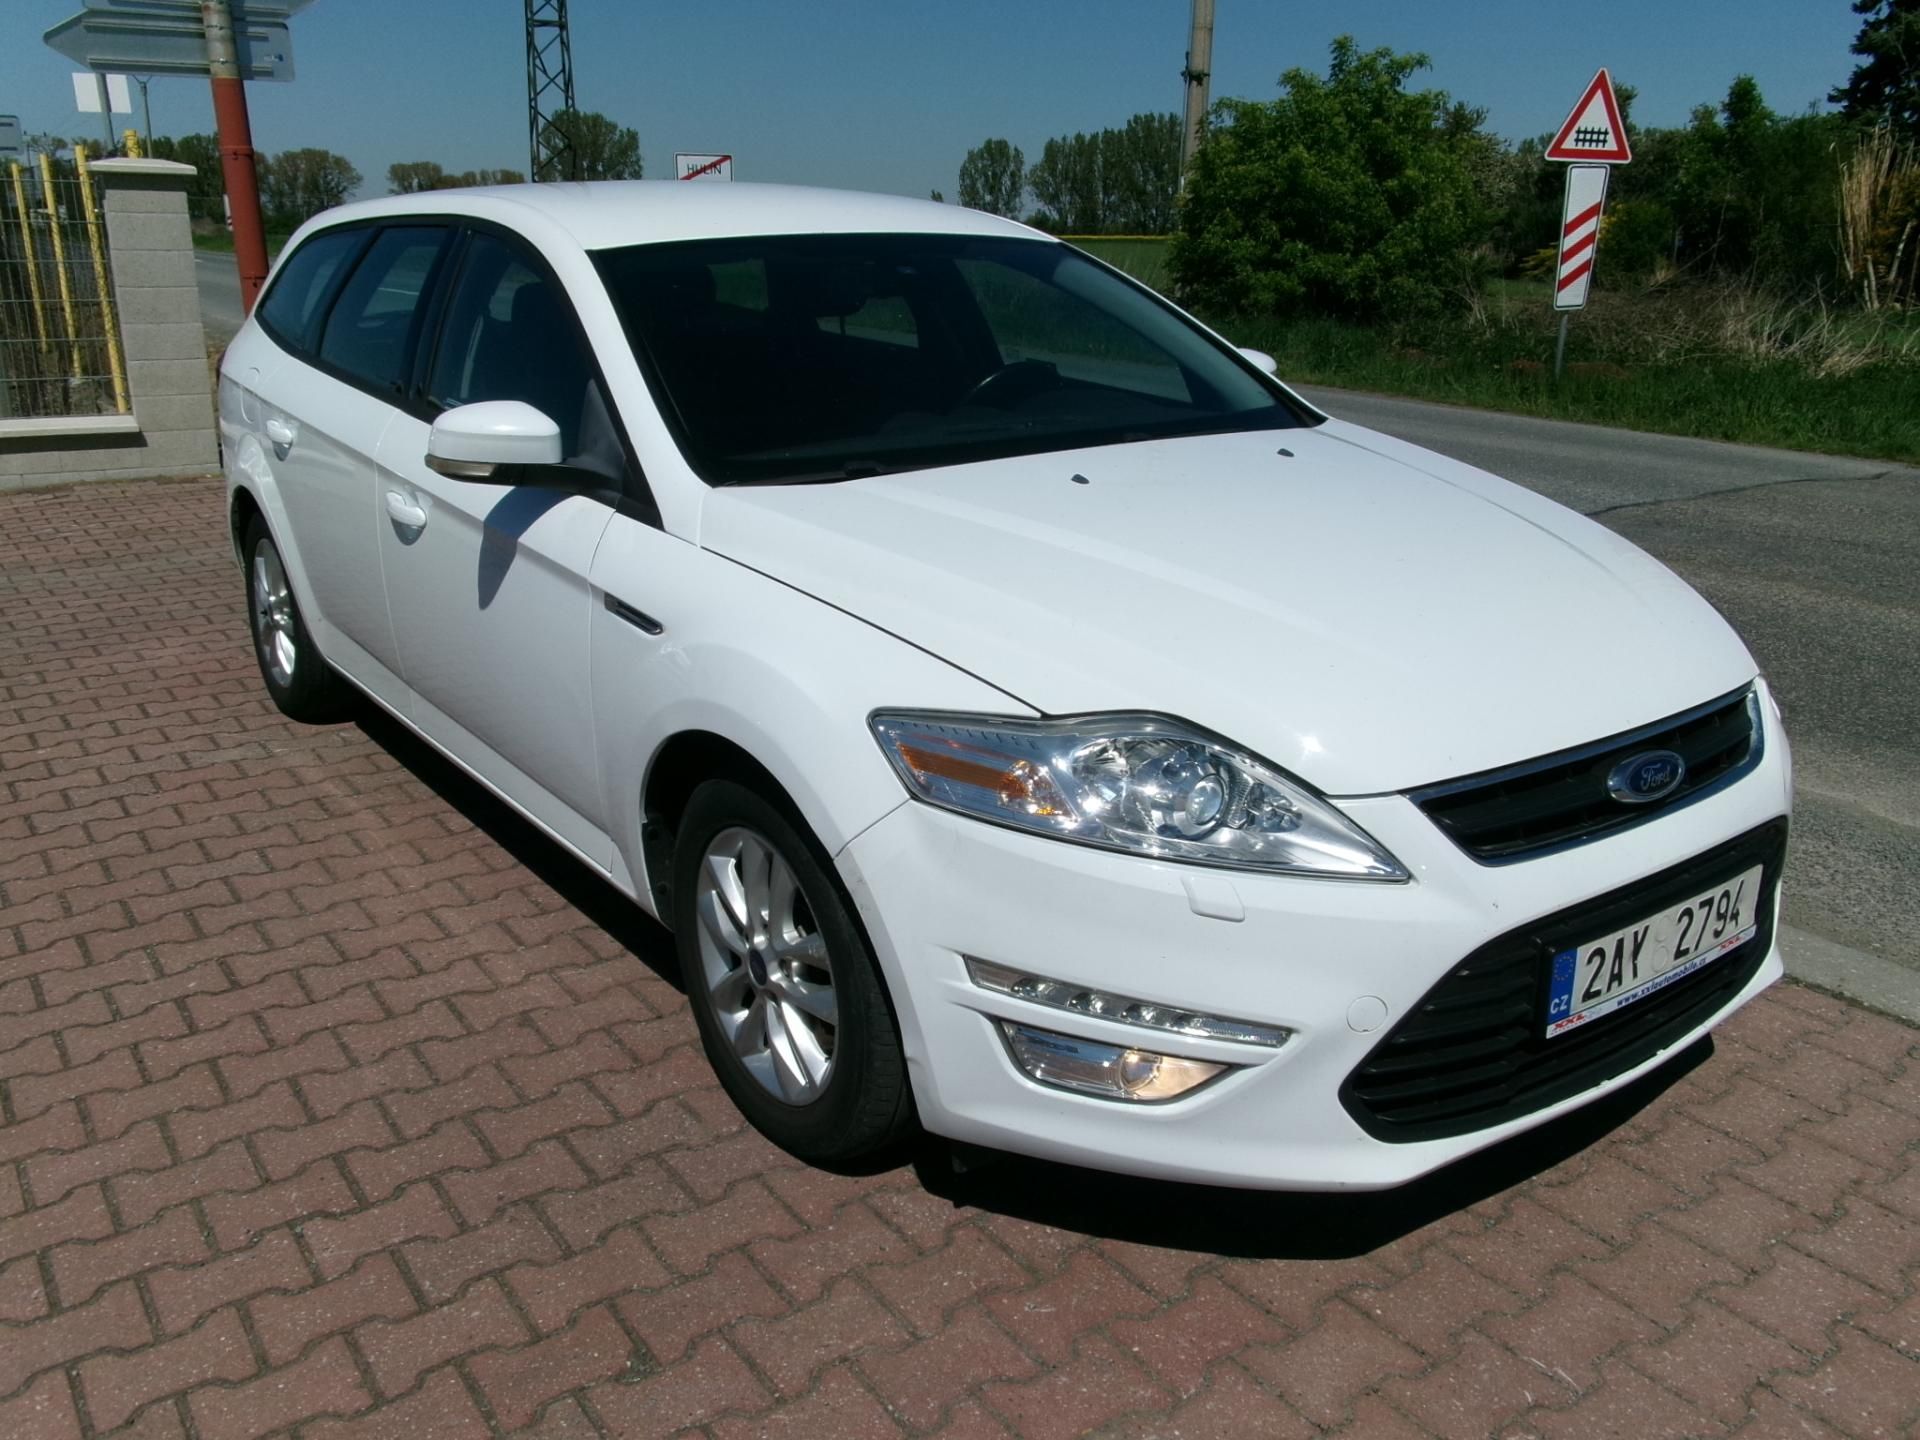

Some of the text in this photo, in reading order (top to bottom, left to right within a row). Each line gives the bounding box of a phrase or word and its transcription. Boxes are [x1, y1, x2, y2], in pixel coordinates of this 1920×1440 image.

[1641, 763, 1671, 790] Ford
[1581, 878, 1745, 1003] 2AY 2794
[1550, 994, 1569, 1014] CZ
